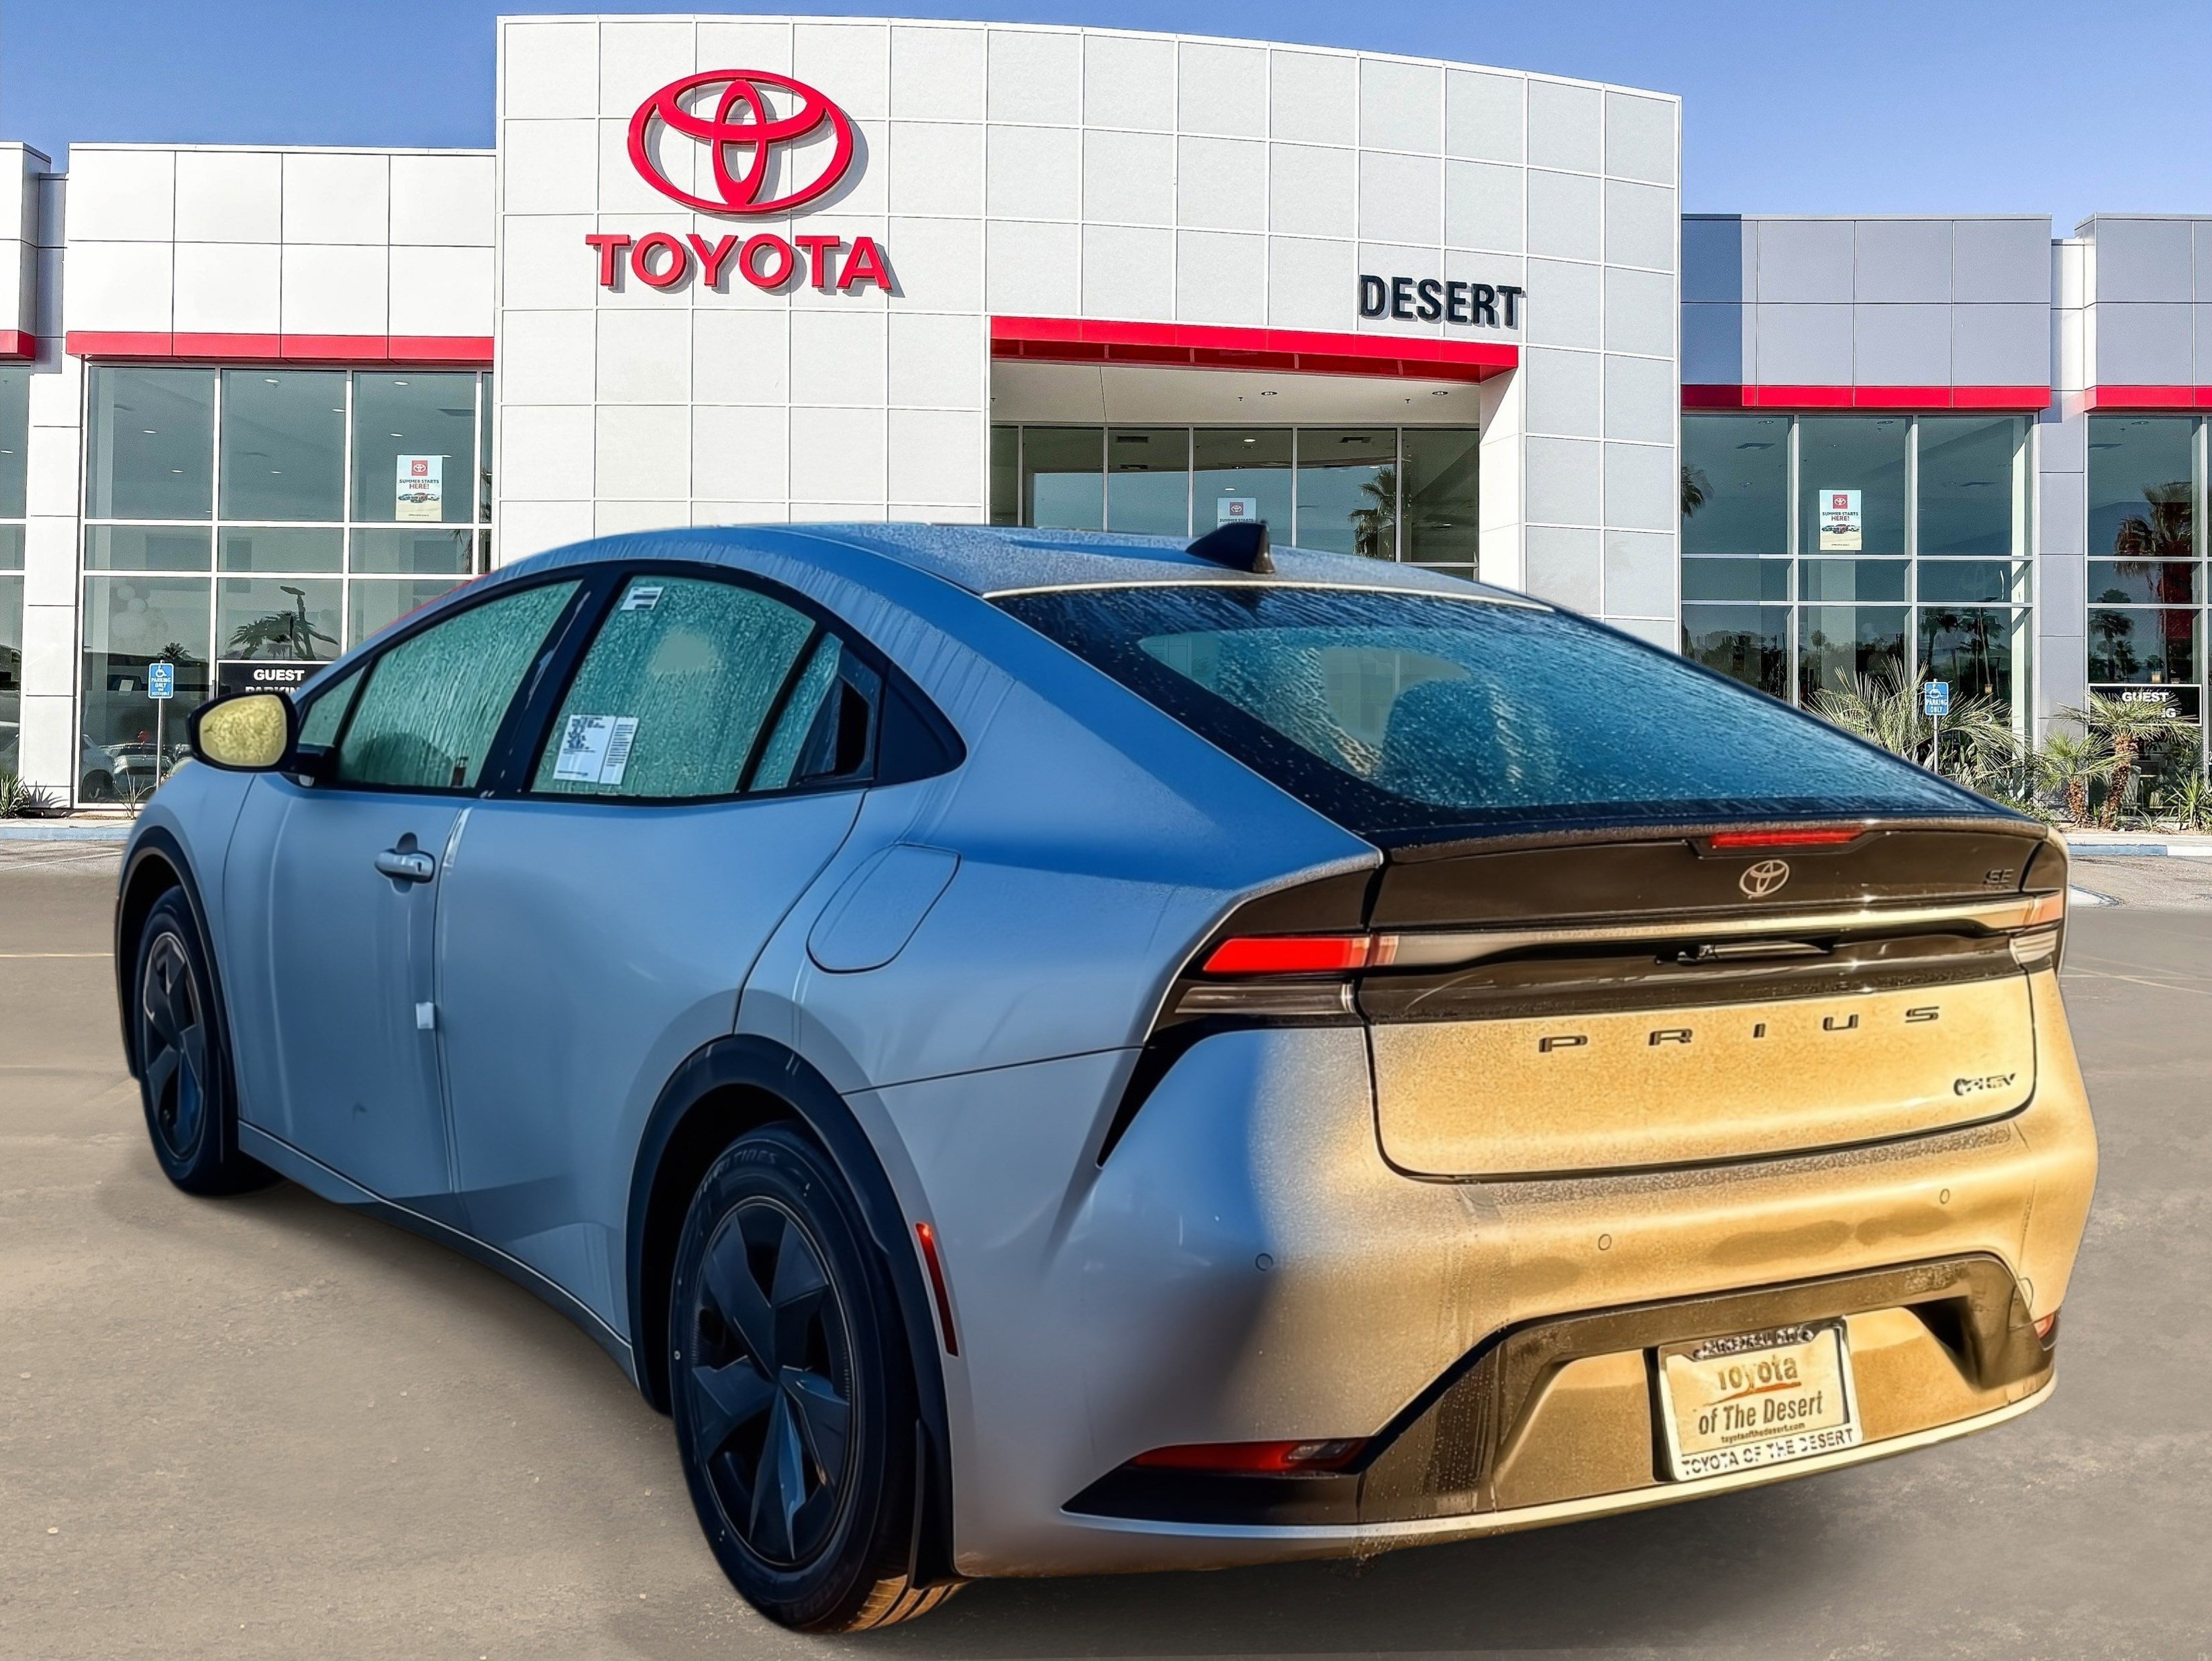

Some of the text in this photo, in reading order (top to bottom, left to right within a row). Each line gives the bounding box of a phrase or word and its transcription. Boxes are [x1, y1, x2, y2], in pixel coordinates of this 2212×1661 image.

[585, 232, 893, 290] TOYOTA
[1358, 274, 1522, 327] DESERT
[245, 686, 301, 694] PARKIN
[253, 668, 305, 681] GUEST
[1930, 705, 1944, 713] ONLY
[2121, 691, 2169, 703] GUEST
[1539, 1006, 1940, 1053] PRIUS
[1717, 1354, 1799, 1391] Toyota
[1699, 1389, 1823, 1435] of The Desert
[1681, 1451, 1740, 1475] TOYOTA
[1799, 1427, 1854, 1453] DESERT
